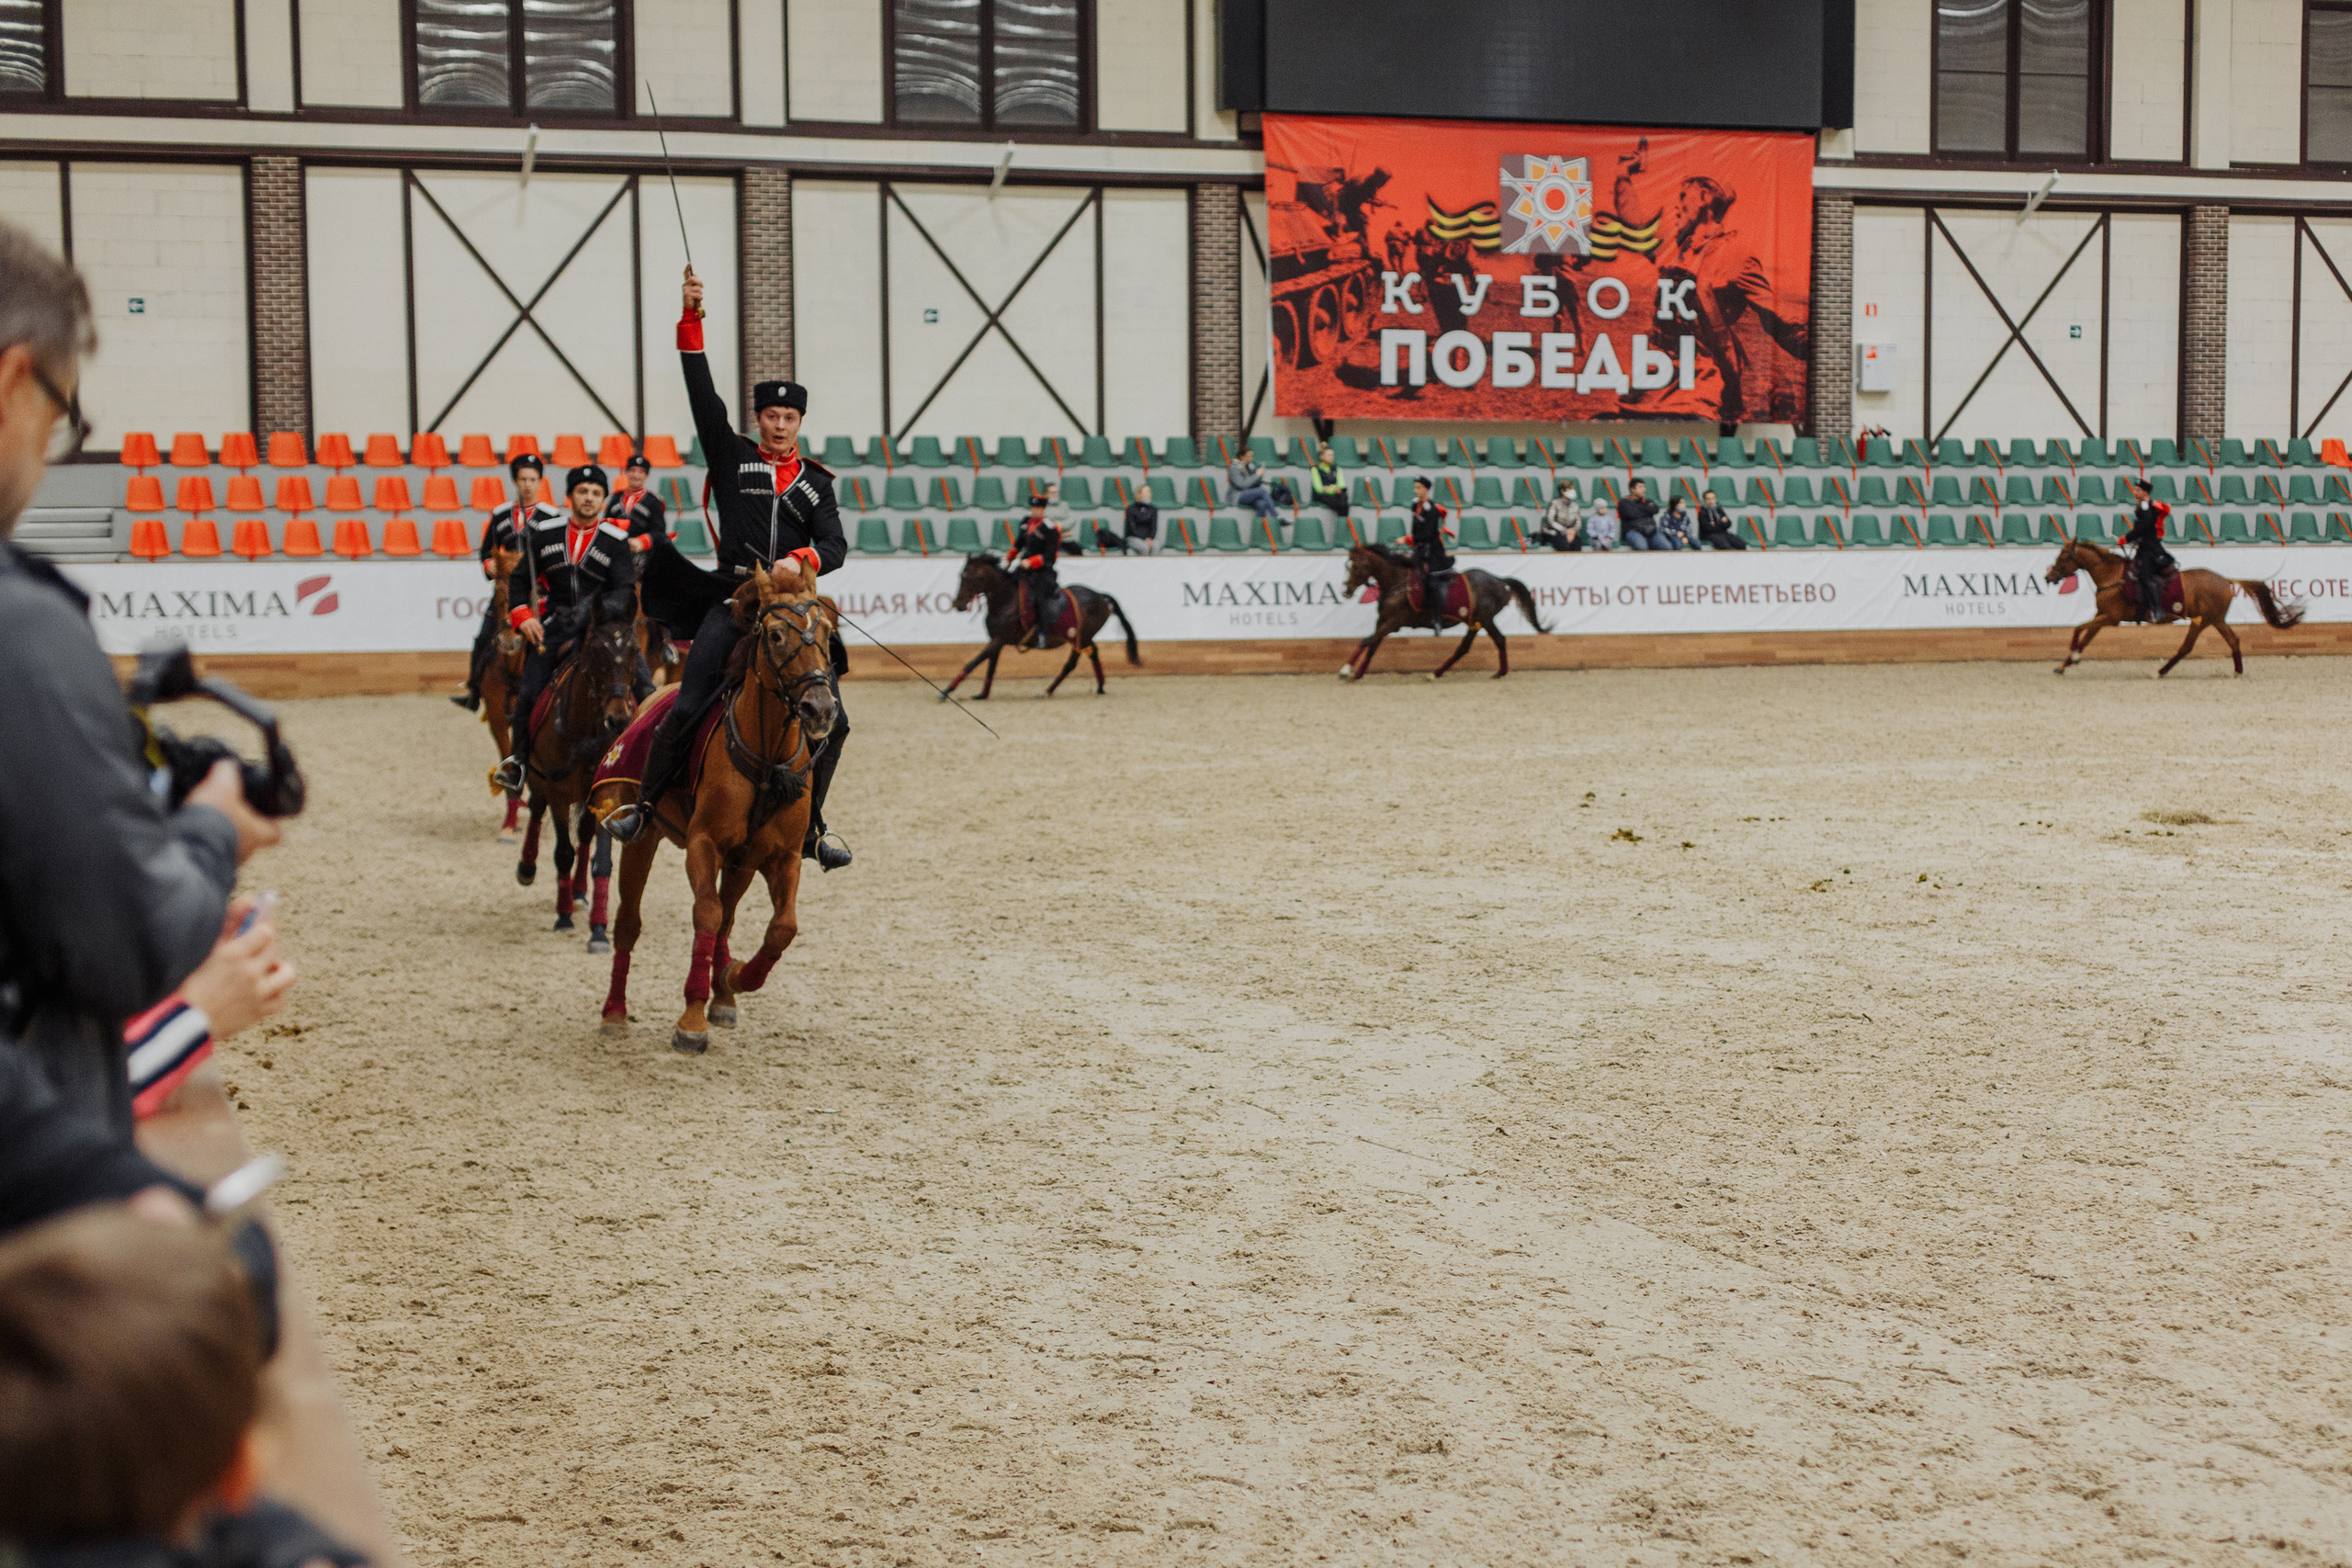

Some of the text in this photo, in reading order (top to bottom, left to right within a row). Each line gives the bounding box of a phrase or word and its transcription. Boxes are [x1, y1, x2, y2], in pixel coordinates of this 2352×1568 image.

[1381, 271, 1697, 321] КУБОК
[1380, 329, 1696, 396] ПОБЕДЫ
[1181, 581, 1343, 606] MAXIMA
[1617, 585, 1650, 606] ОТ
[1657, 581, 1837, 605] ШЕРЕМЕТЬЕВО
[1902, 572, 2044, 597] MAXIMA
[2308, 578, 2352, 598] ОТЕ
[96, 589, 290, 619] MAXIMA
[836, 592, 908, 617] ЩАЯ
[1944, 602, 2007, 615] HOTELS
[1228, 612, 1298, 626] HOTELS
[153, 624, 239, 640] HOTELS
